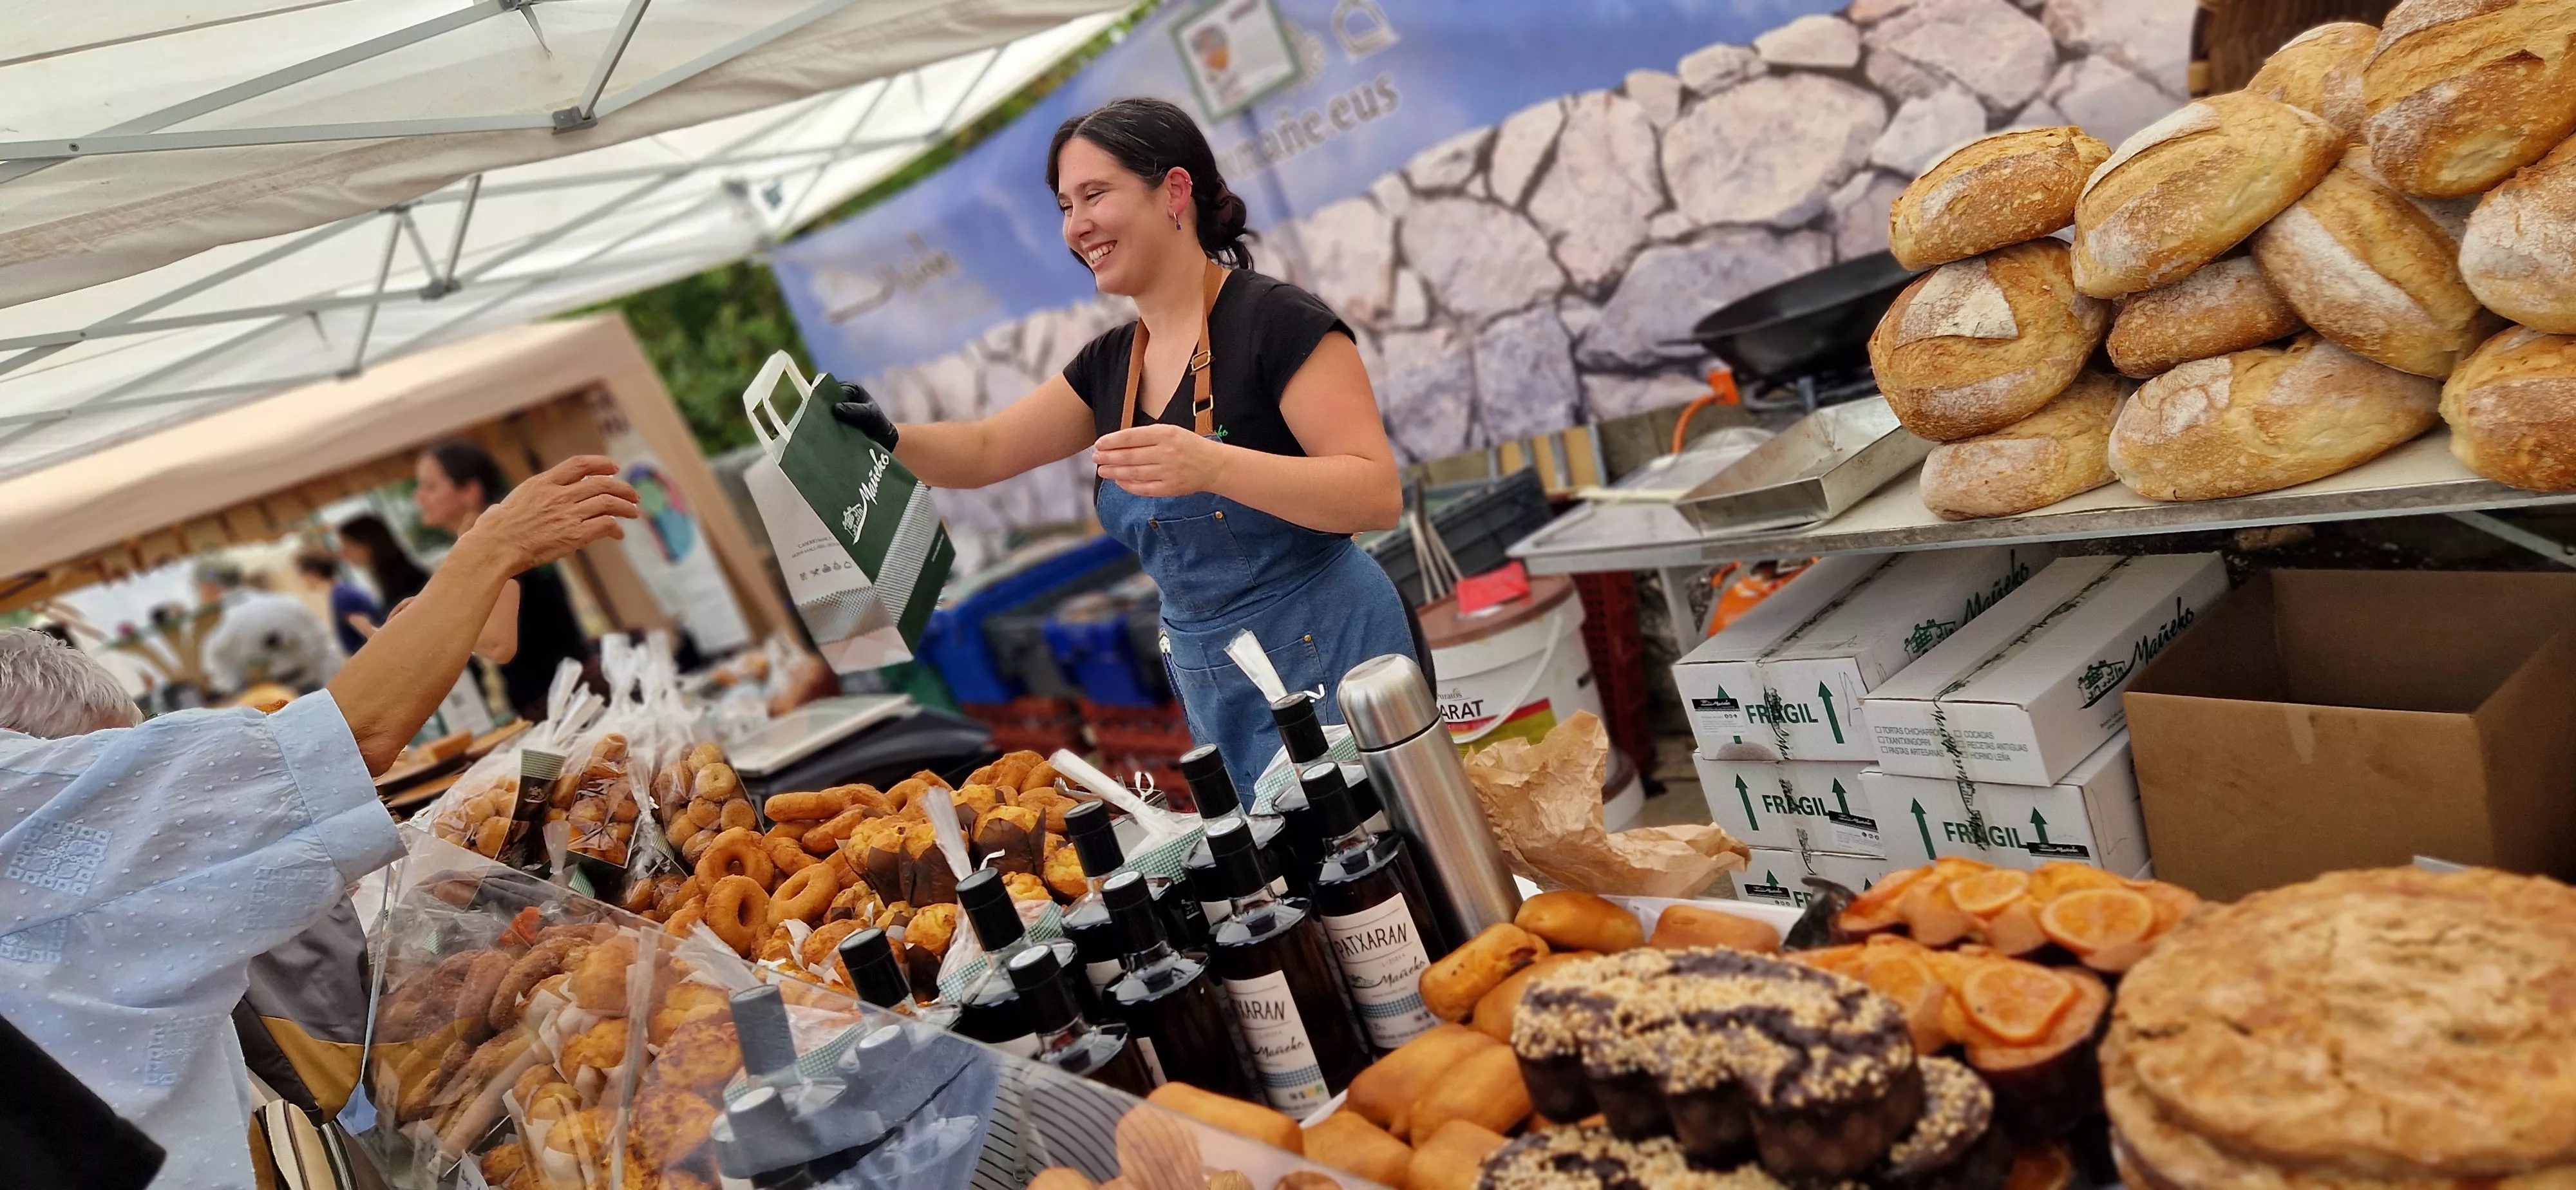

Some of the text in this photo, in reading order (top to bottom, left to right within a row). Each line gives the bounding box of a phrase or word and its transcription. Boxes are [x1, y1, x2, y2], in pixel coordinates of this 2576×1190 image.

[858, 448, 889, 507] Mañeko
[2132, 596, 2195, 666] Mañeko
[1745, 703, 1819, 724] FRAGIL
[1882, 726, 1904, 735] TORTAS
[1964, 730, 1994, 739] COCADAS
[1888, 746, 1910, 755] PASTAS
[1761, 794, 1830, 817] FRAGIL
[1942, 822, 2027, 849] FRAGIL
[1334, 922, 1406, 959] PATXARAN
[1380, 956, 1426, 988] Mañeko
[1258, 1035, 1305, 1060] Mañeko
